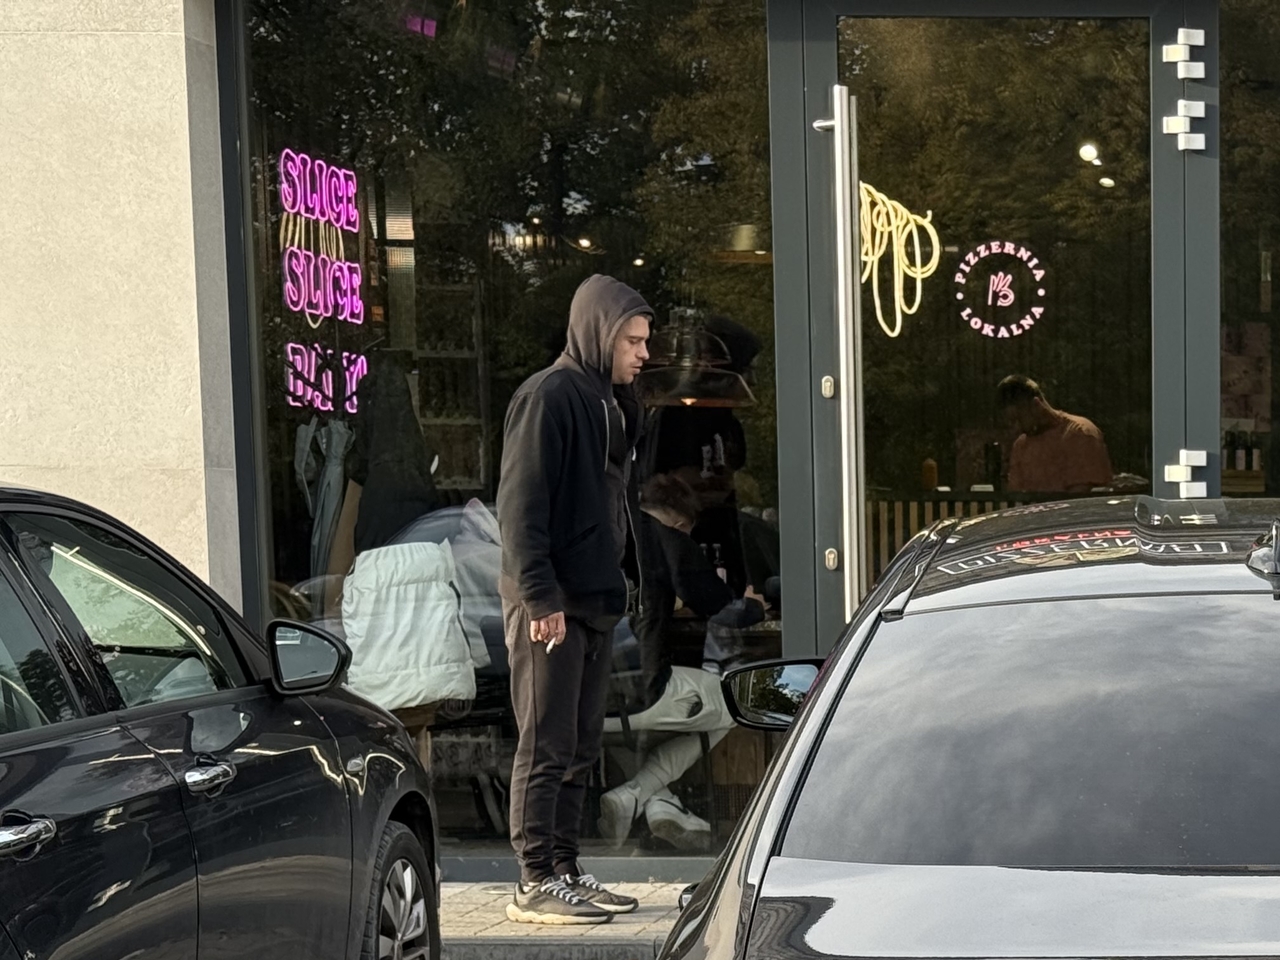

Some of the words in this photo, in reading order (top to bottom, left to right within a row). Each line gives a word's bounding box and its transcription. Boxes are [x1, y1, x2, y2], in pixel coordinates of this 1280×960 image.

[280, 148, 360, 233] SLICE
[285, 246, 364, 325] SLICE
[954, 241, 1046, 284] PIZZERNIA
[960, 307, 1045, 338] LOKALNA
